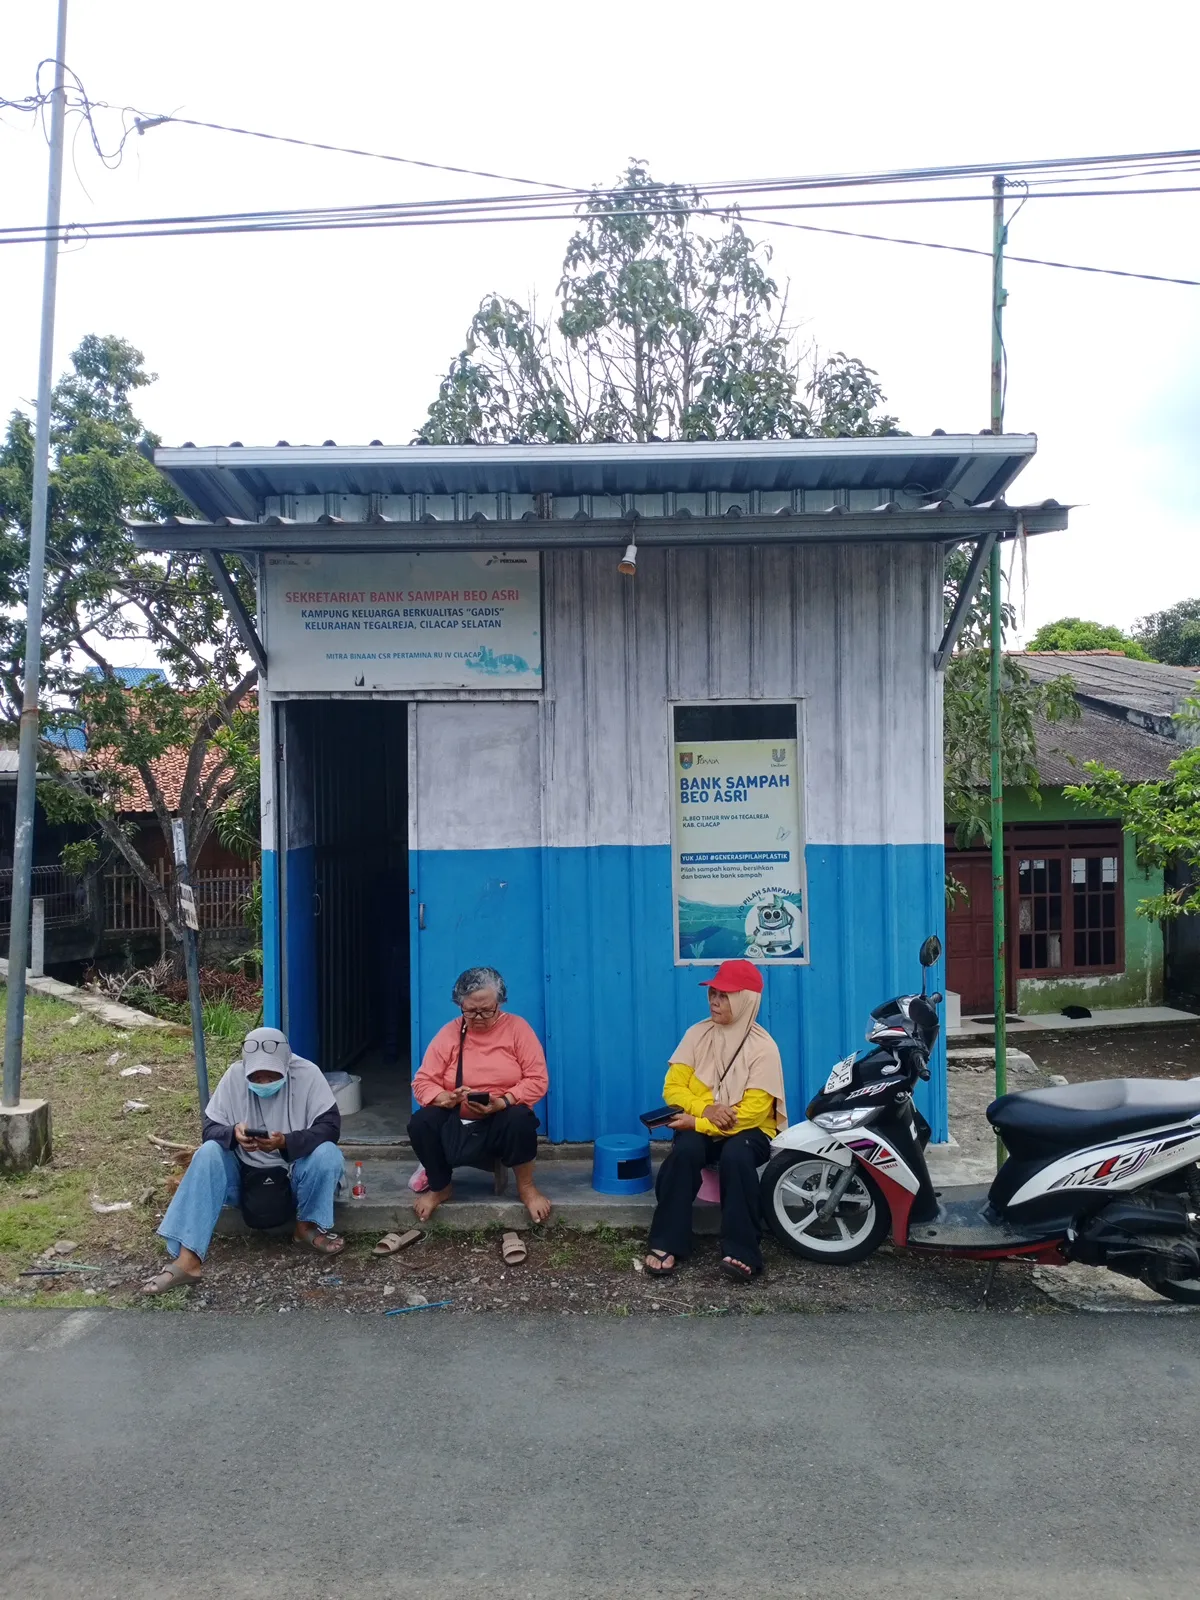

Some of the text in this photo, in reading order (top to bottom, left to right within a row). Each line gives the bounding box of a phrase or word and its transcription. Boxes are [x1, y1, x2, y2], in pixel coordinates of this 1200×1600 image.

[285, 589, 519, 603] SEKRETARIAT BANK SAMPAH BEO ASRI
[301, 609, 349, 618] KAMPUNG
[352, 609, 400, 618] KELUARGA
[403, 608, 463, 617] BERKUALITAS
[305, 619, 502, 630] KELURAHAN TEGALREJA, CILACAP SELATAN
[680, 774, 790, 791] BANK SAMPAH
[680, 789, 748, 804] BEO ASRI
[710, 853, 788, 861] #GENERASIPILAHPLASTIK
[742, 890, 761, 906] PILAH
[762, 886, 795, 897] SAMPAH!
